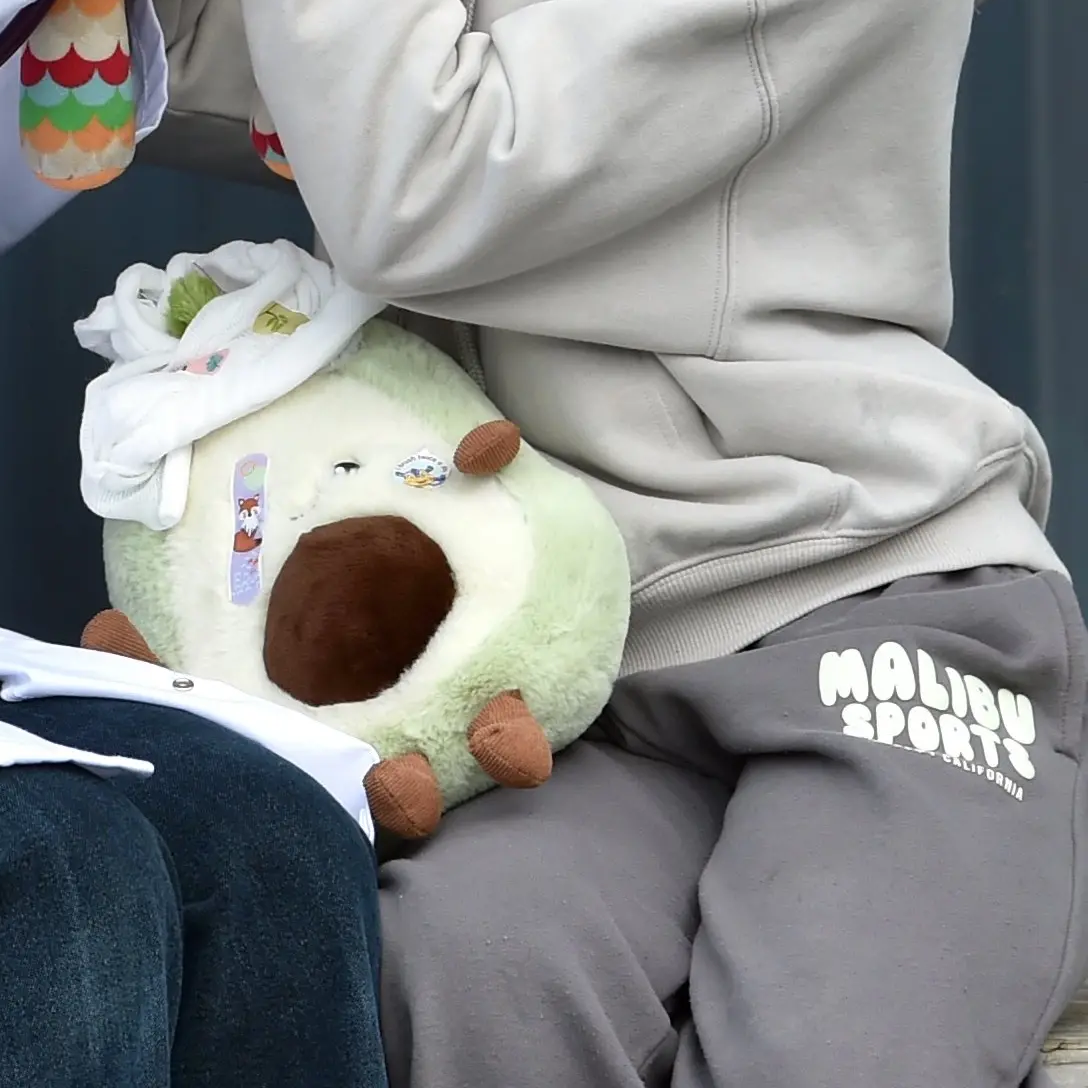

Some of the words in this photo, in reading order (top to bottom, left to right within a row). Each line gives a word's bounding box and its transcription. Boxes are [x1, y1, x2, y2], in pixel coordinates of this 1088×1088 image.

[818, 641, 1036, 745] MALIBU
[841, 701, 1036, 780] SPORTS
[942, 753, 1024, 801] CALIFORNIA
